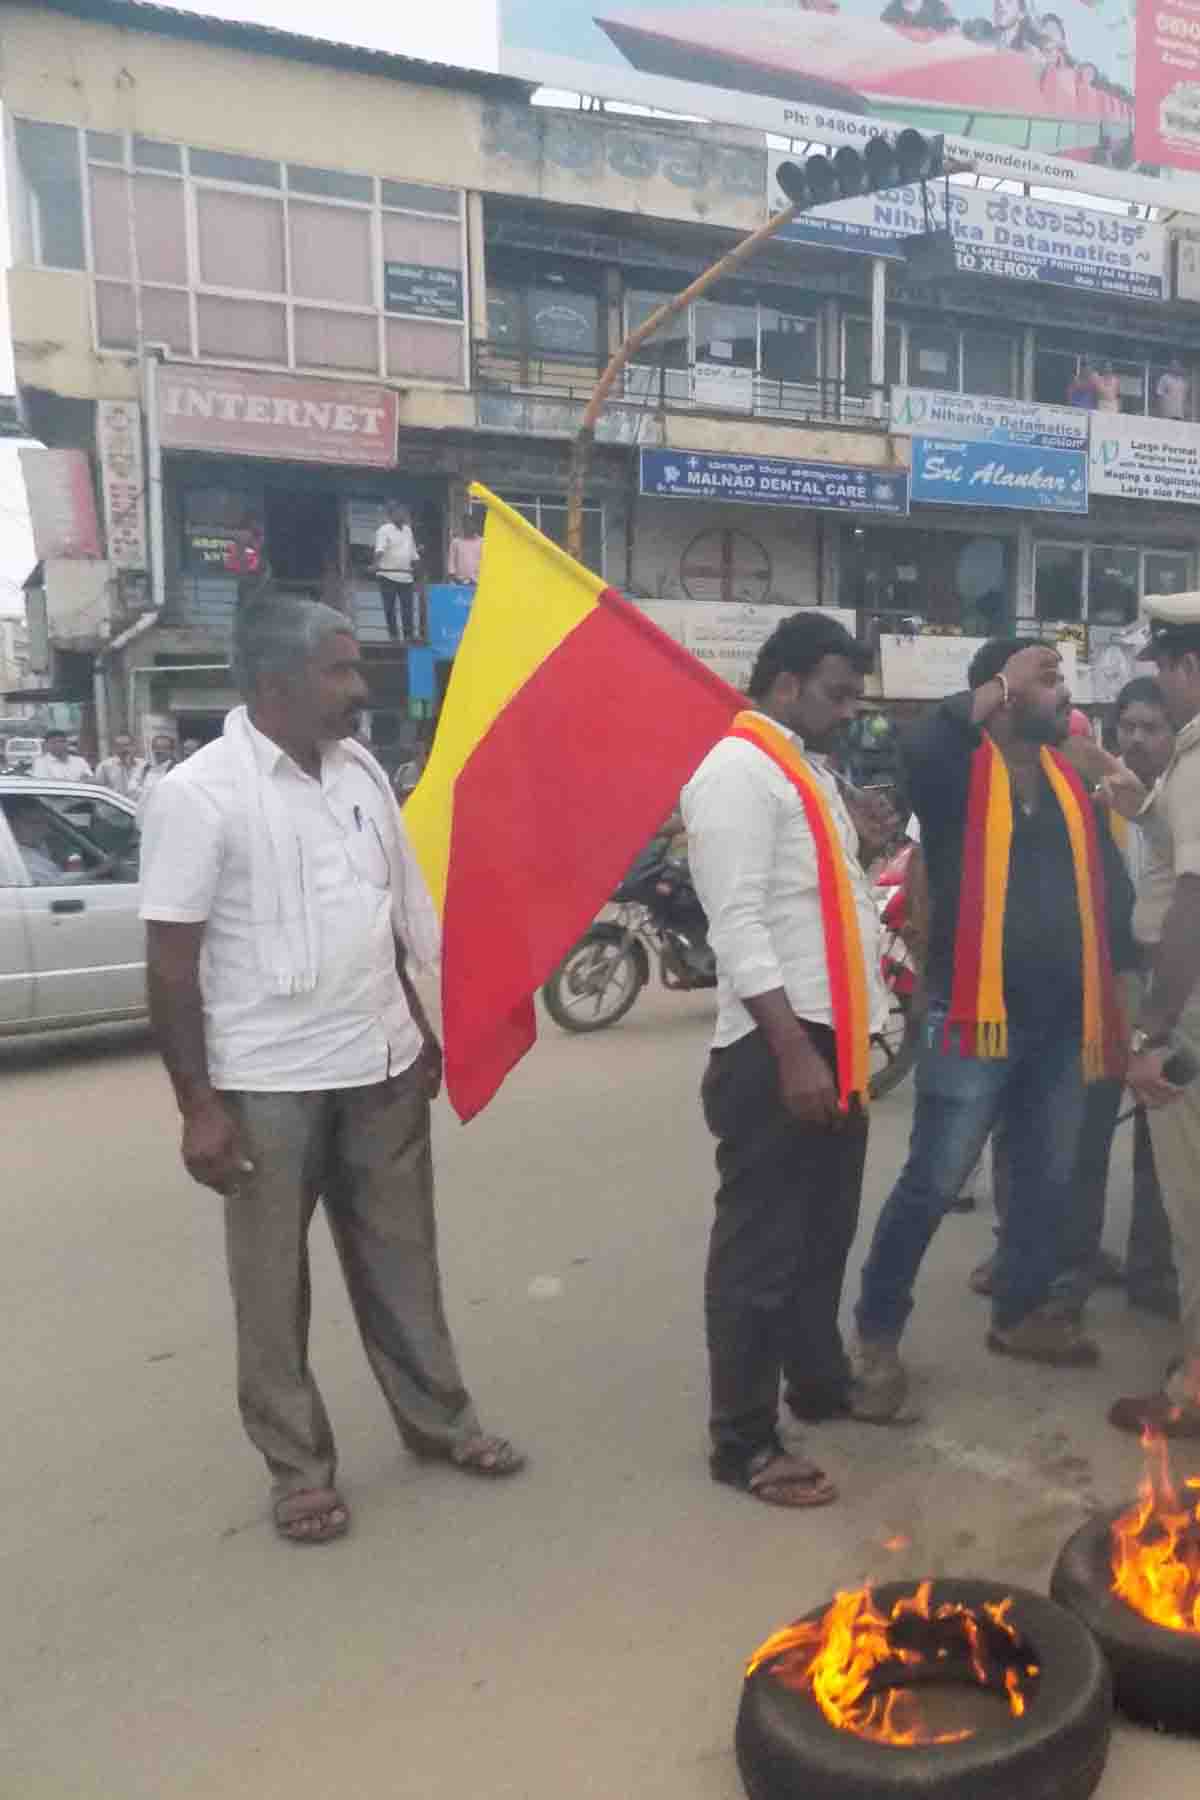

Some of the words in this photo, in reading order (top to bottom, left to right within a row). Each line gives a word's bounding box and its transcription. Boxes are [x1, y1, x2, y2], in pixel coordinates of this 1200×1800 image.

[783, 108, 809, 126] Ph:
[994, 226, 1131, 268] Datamatics
[981, 257, 1040, 280] XEROX
[165, 386, 385, 433] INTERNET
[1130, 440, 1160, 452] Large
[1162, 443, 1197, 456] Format
[687, 471, 755, 488] MALNAD
[760, 476, 823, 495] DENTAL
[825, 483, 867, 498] CARE
[1121, 484, 1150, 497] Large
